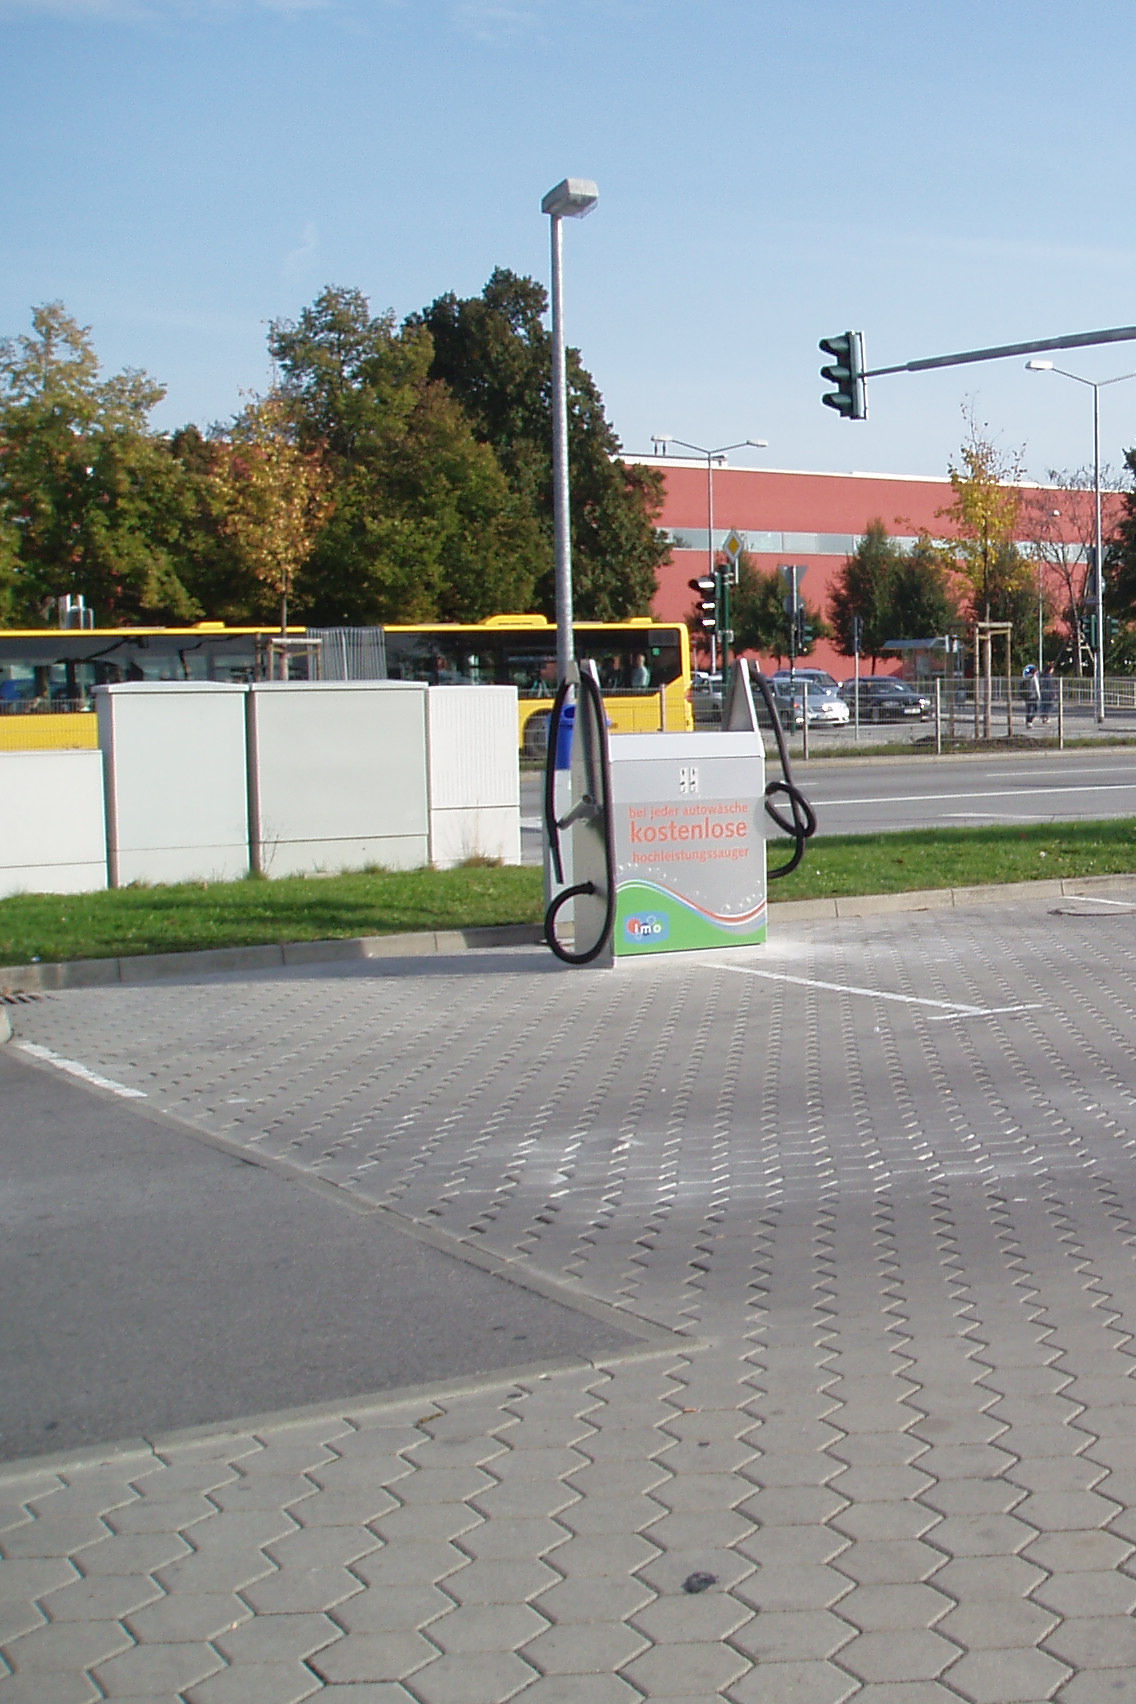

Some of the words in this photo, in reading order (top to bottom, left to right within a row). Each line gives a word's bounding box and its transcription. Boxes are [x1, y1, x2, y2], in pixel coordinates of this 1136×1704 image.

[628, 806, 646, 818] bei
[650, 804, 678, 820] jeder
[682, 801, 748, 815] autowäsche
[630, 816, 747, 843] kostenlose
[632, 847, 748, 862] hochleistungssauger
